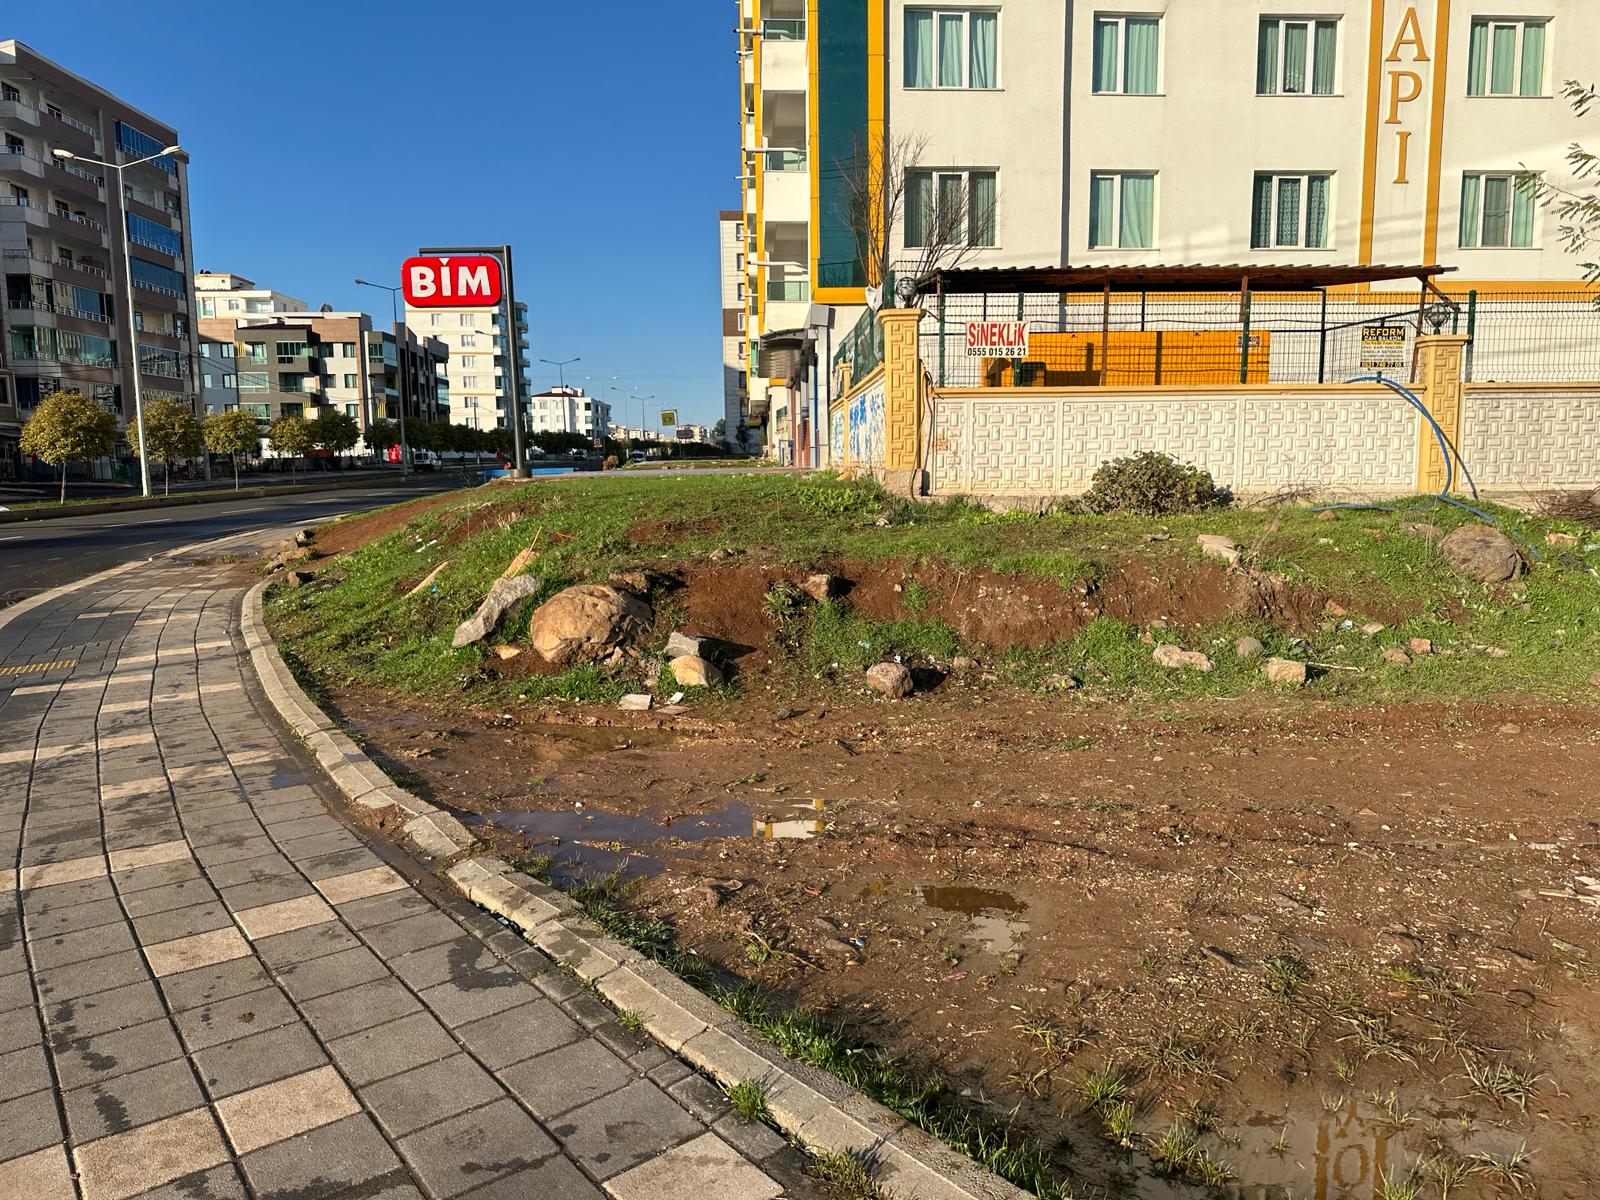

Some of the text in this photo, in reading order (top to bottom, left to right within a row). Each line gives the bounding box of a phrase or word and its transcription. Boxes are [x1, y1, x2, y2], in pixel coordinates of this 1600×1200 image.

[410, 257, 492, 298] BİM
[967, 347, 1026, 356] 0555 015 26 21
